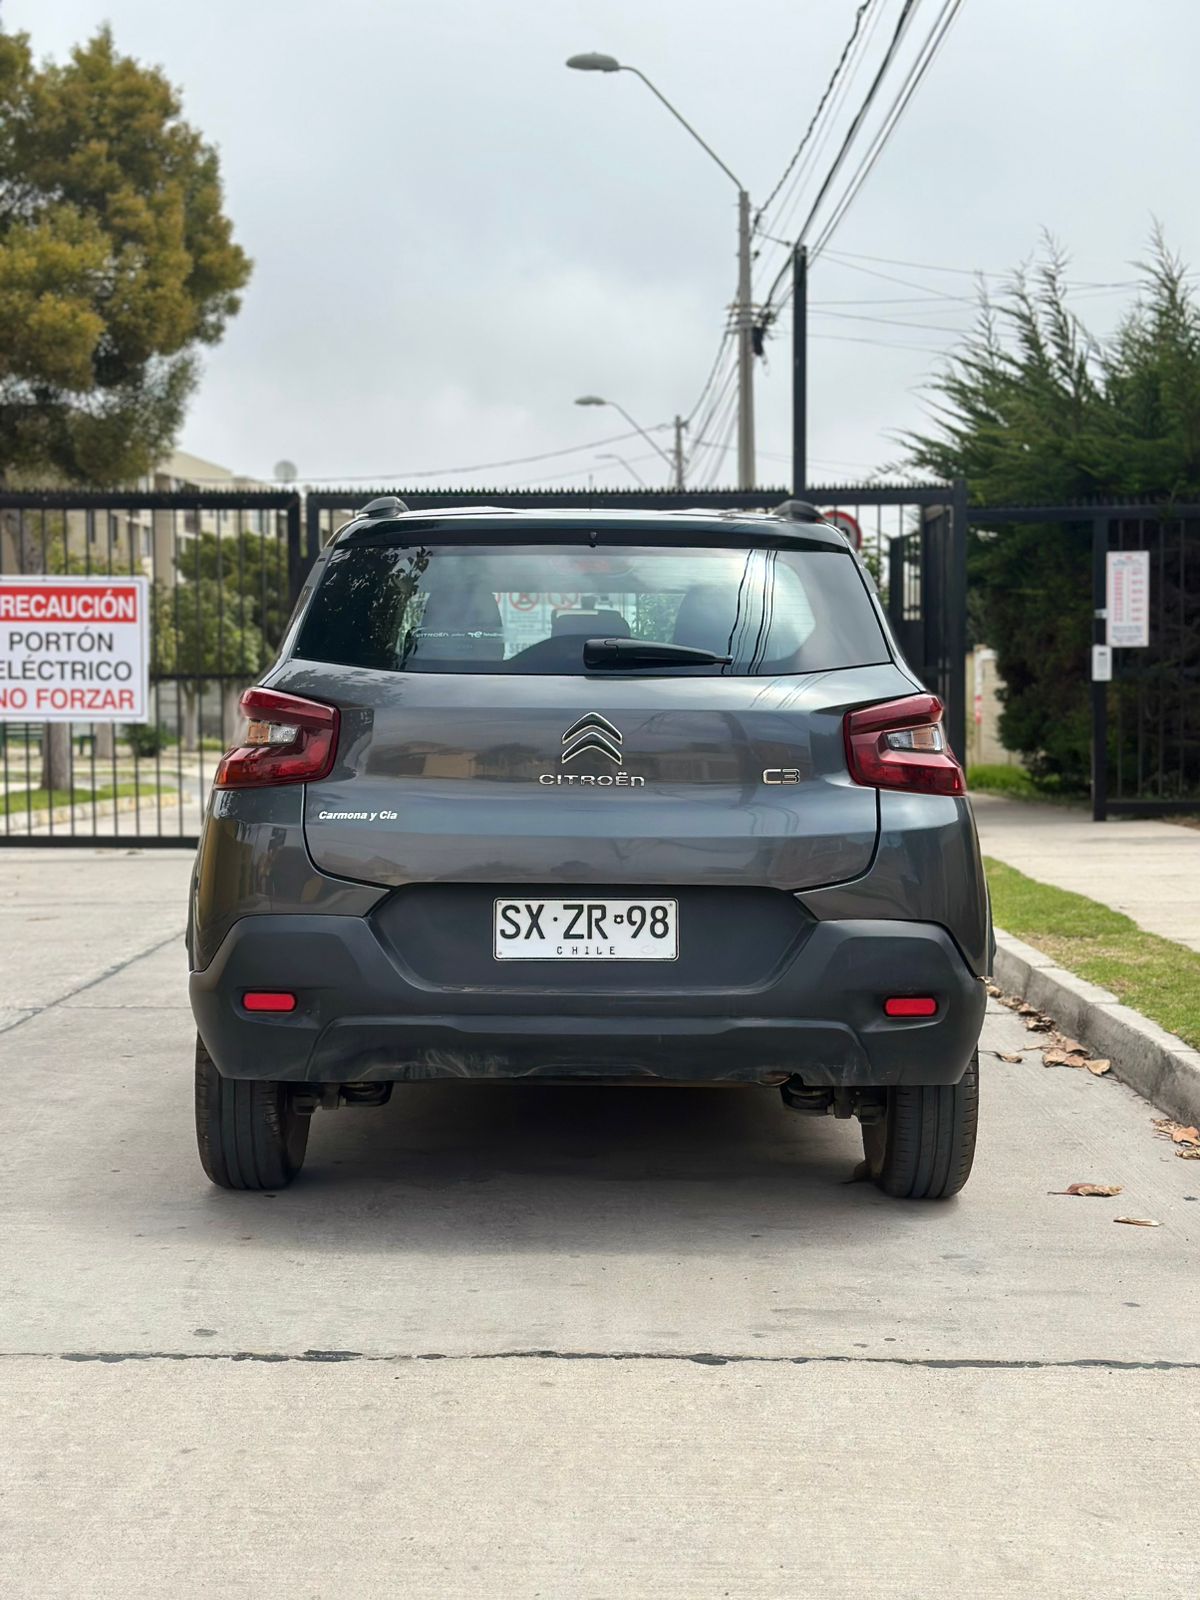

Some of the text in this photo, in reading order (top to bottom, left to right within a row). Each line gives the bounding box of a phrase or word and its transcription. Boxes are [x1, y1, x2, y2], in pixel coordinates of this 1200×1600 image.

[9, 626, 113, 652] PORTÓN
[36, 688, 134, 709] FORZAR
[538, 772, 645, 787] CITROËN
[762, 768, 800, 785] C3
[319, 811, 398, 821] Carmona y Cia
[556, 946, 616, 955] CHILE
